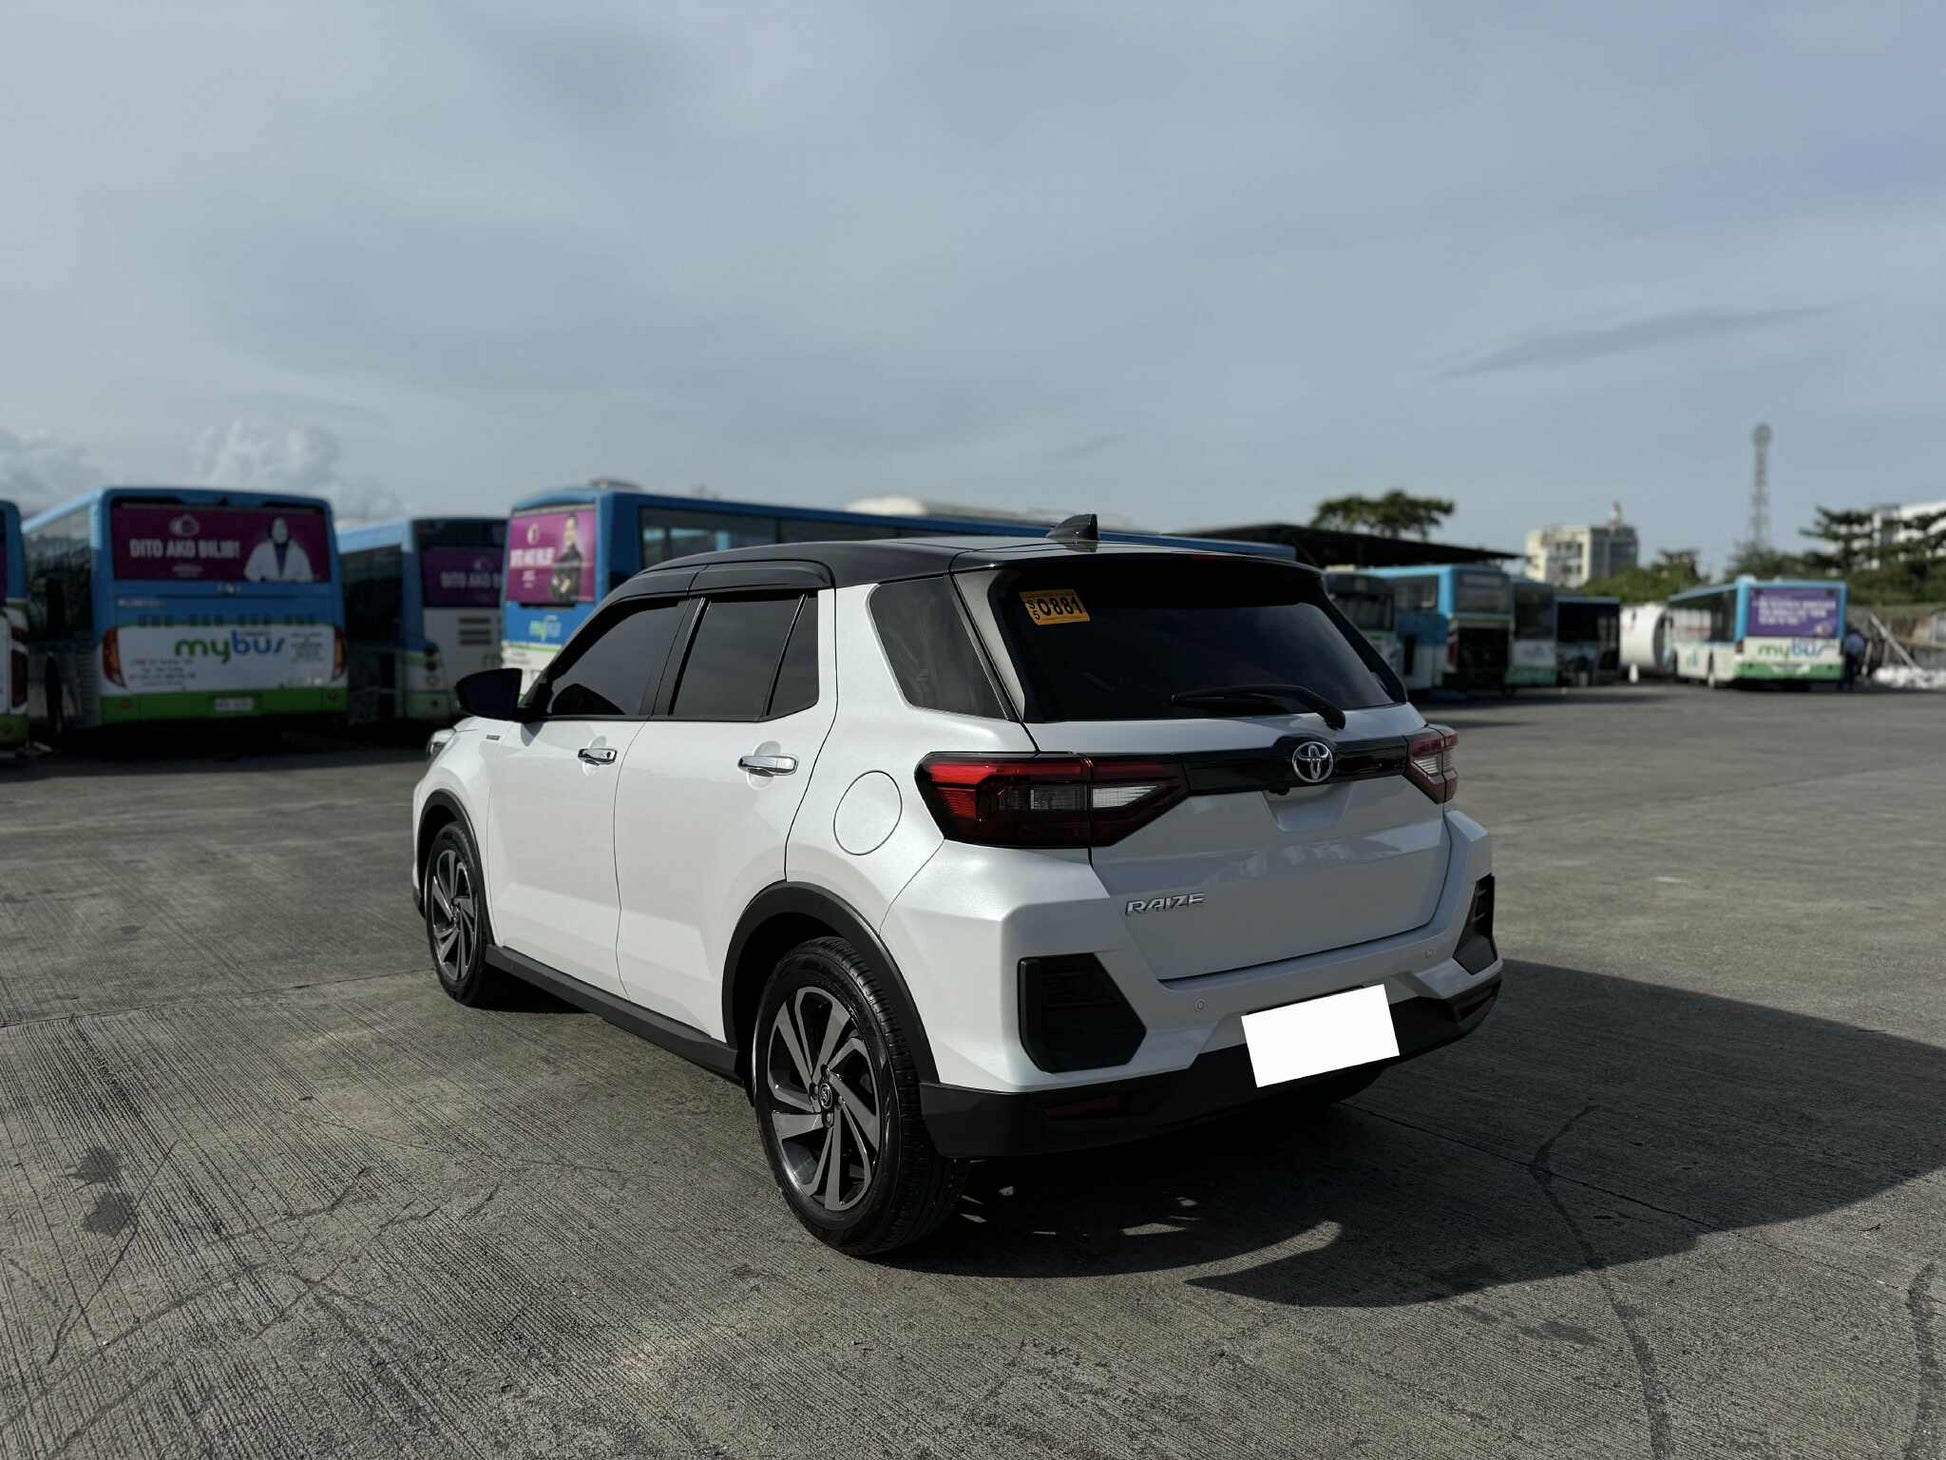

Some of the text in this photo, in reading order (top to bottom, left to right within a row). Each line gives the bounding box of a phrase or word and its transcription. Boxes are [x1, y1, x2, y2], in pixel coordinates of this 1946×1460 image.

[1037, 597, 1083, 616] 0881
[174, 630, 286, 664] mybus
[1125, 892, 1206, 915] RAIZE
